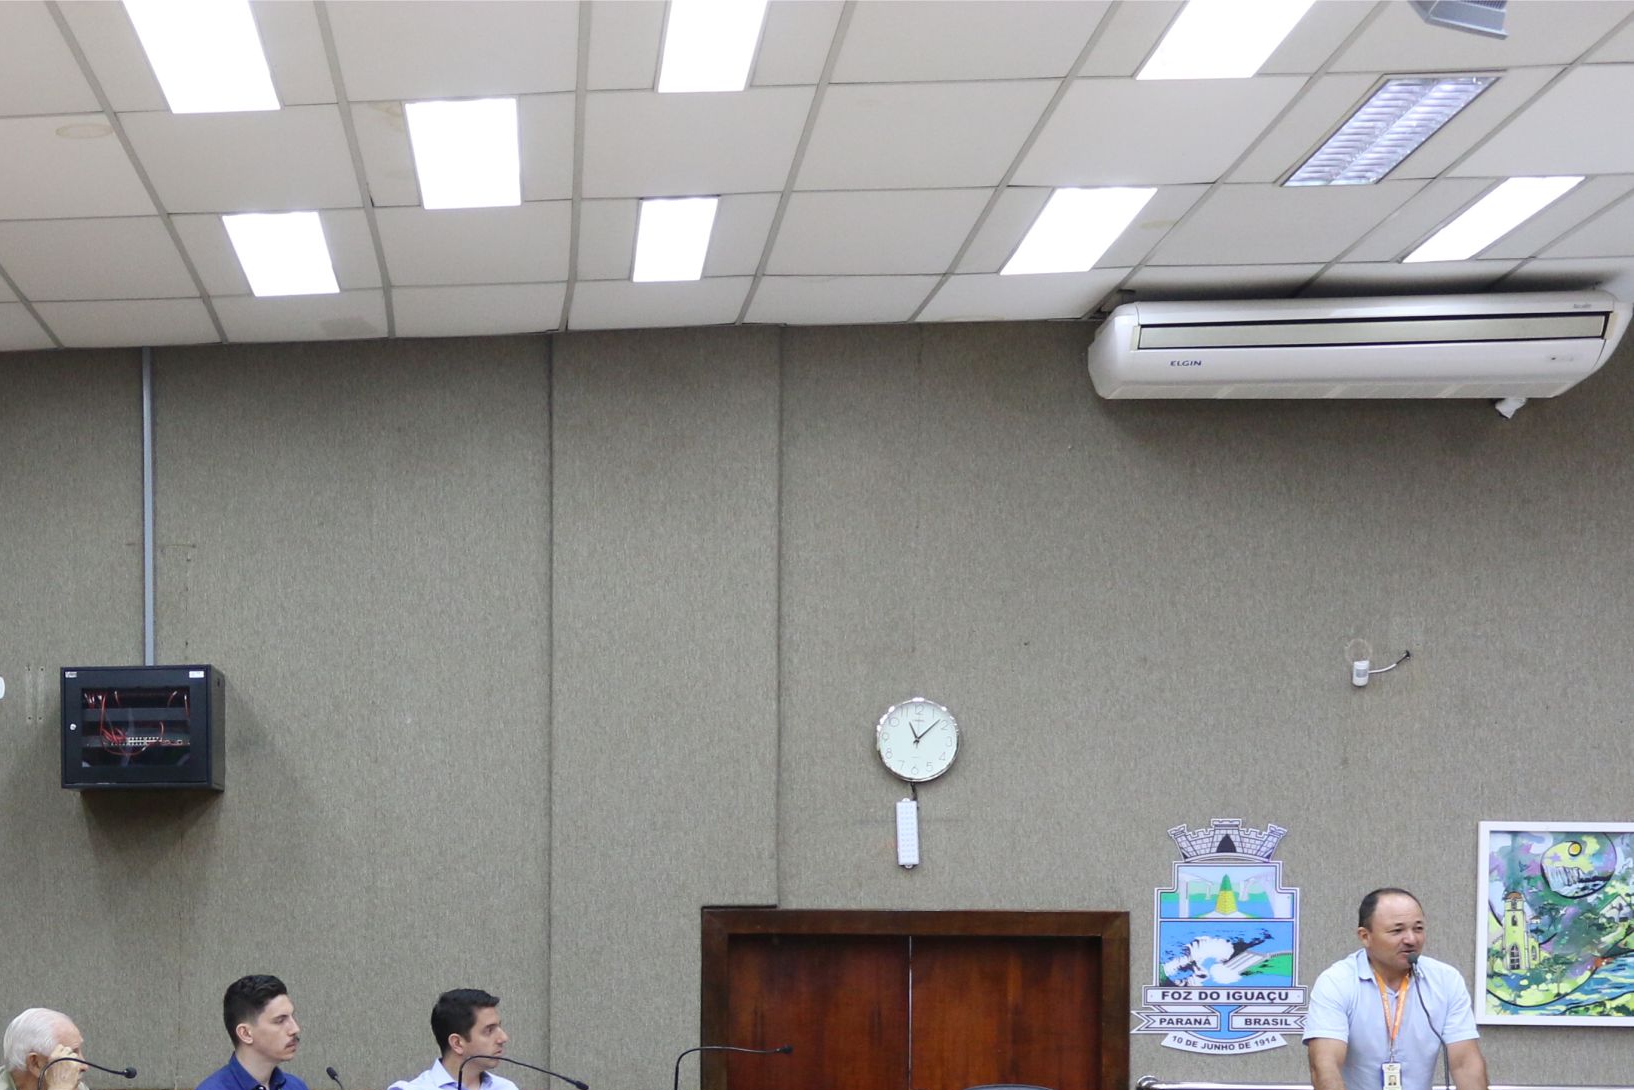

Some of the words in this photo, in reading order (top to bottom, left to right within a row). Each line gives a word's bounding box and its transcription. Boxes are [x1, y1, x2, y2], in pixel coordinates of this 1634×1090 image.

[1161, 991, 1193, 1001] FOZ
[1198, 991, 1221, 1001] DO
[1226, 991, 1289, 1004] IGUAÇU
[1158, 1016, 1212, 1026] PARANÁ
[1244, 1017, 1292, 1026] BRASIL
[1172, 1035, 1183, 1044] 10
[1185, 1038, 1198, 1048] DE
[1200, 1042, 1235, 1051] JUNHO
[1238, 1040, 1252, 1050] DE
[1254, 1035, 1277, 1047] 1914
